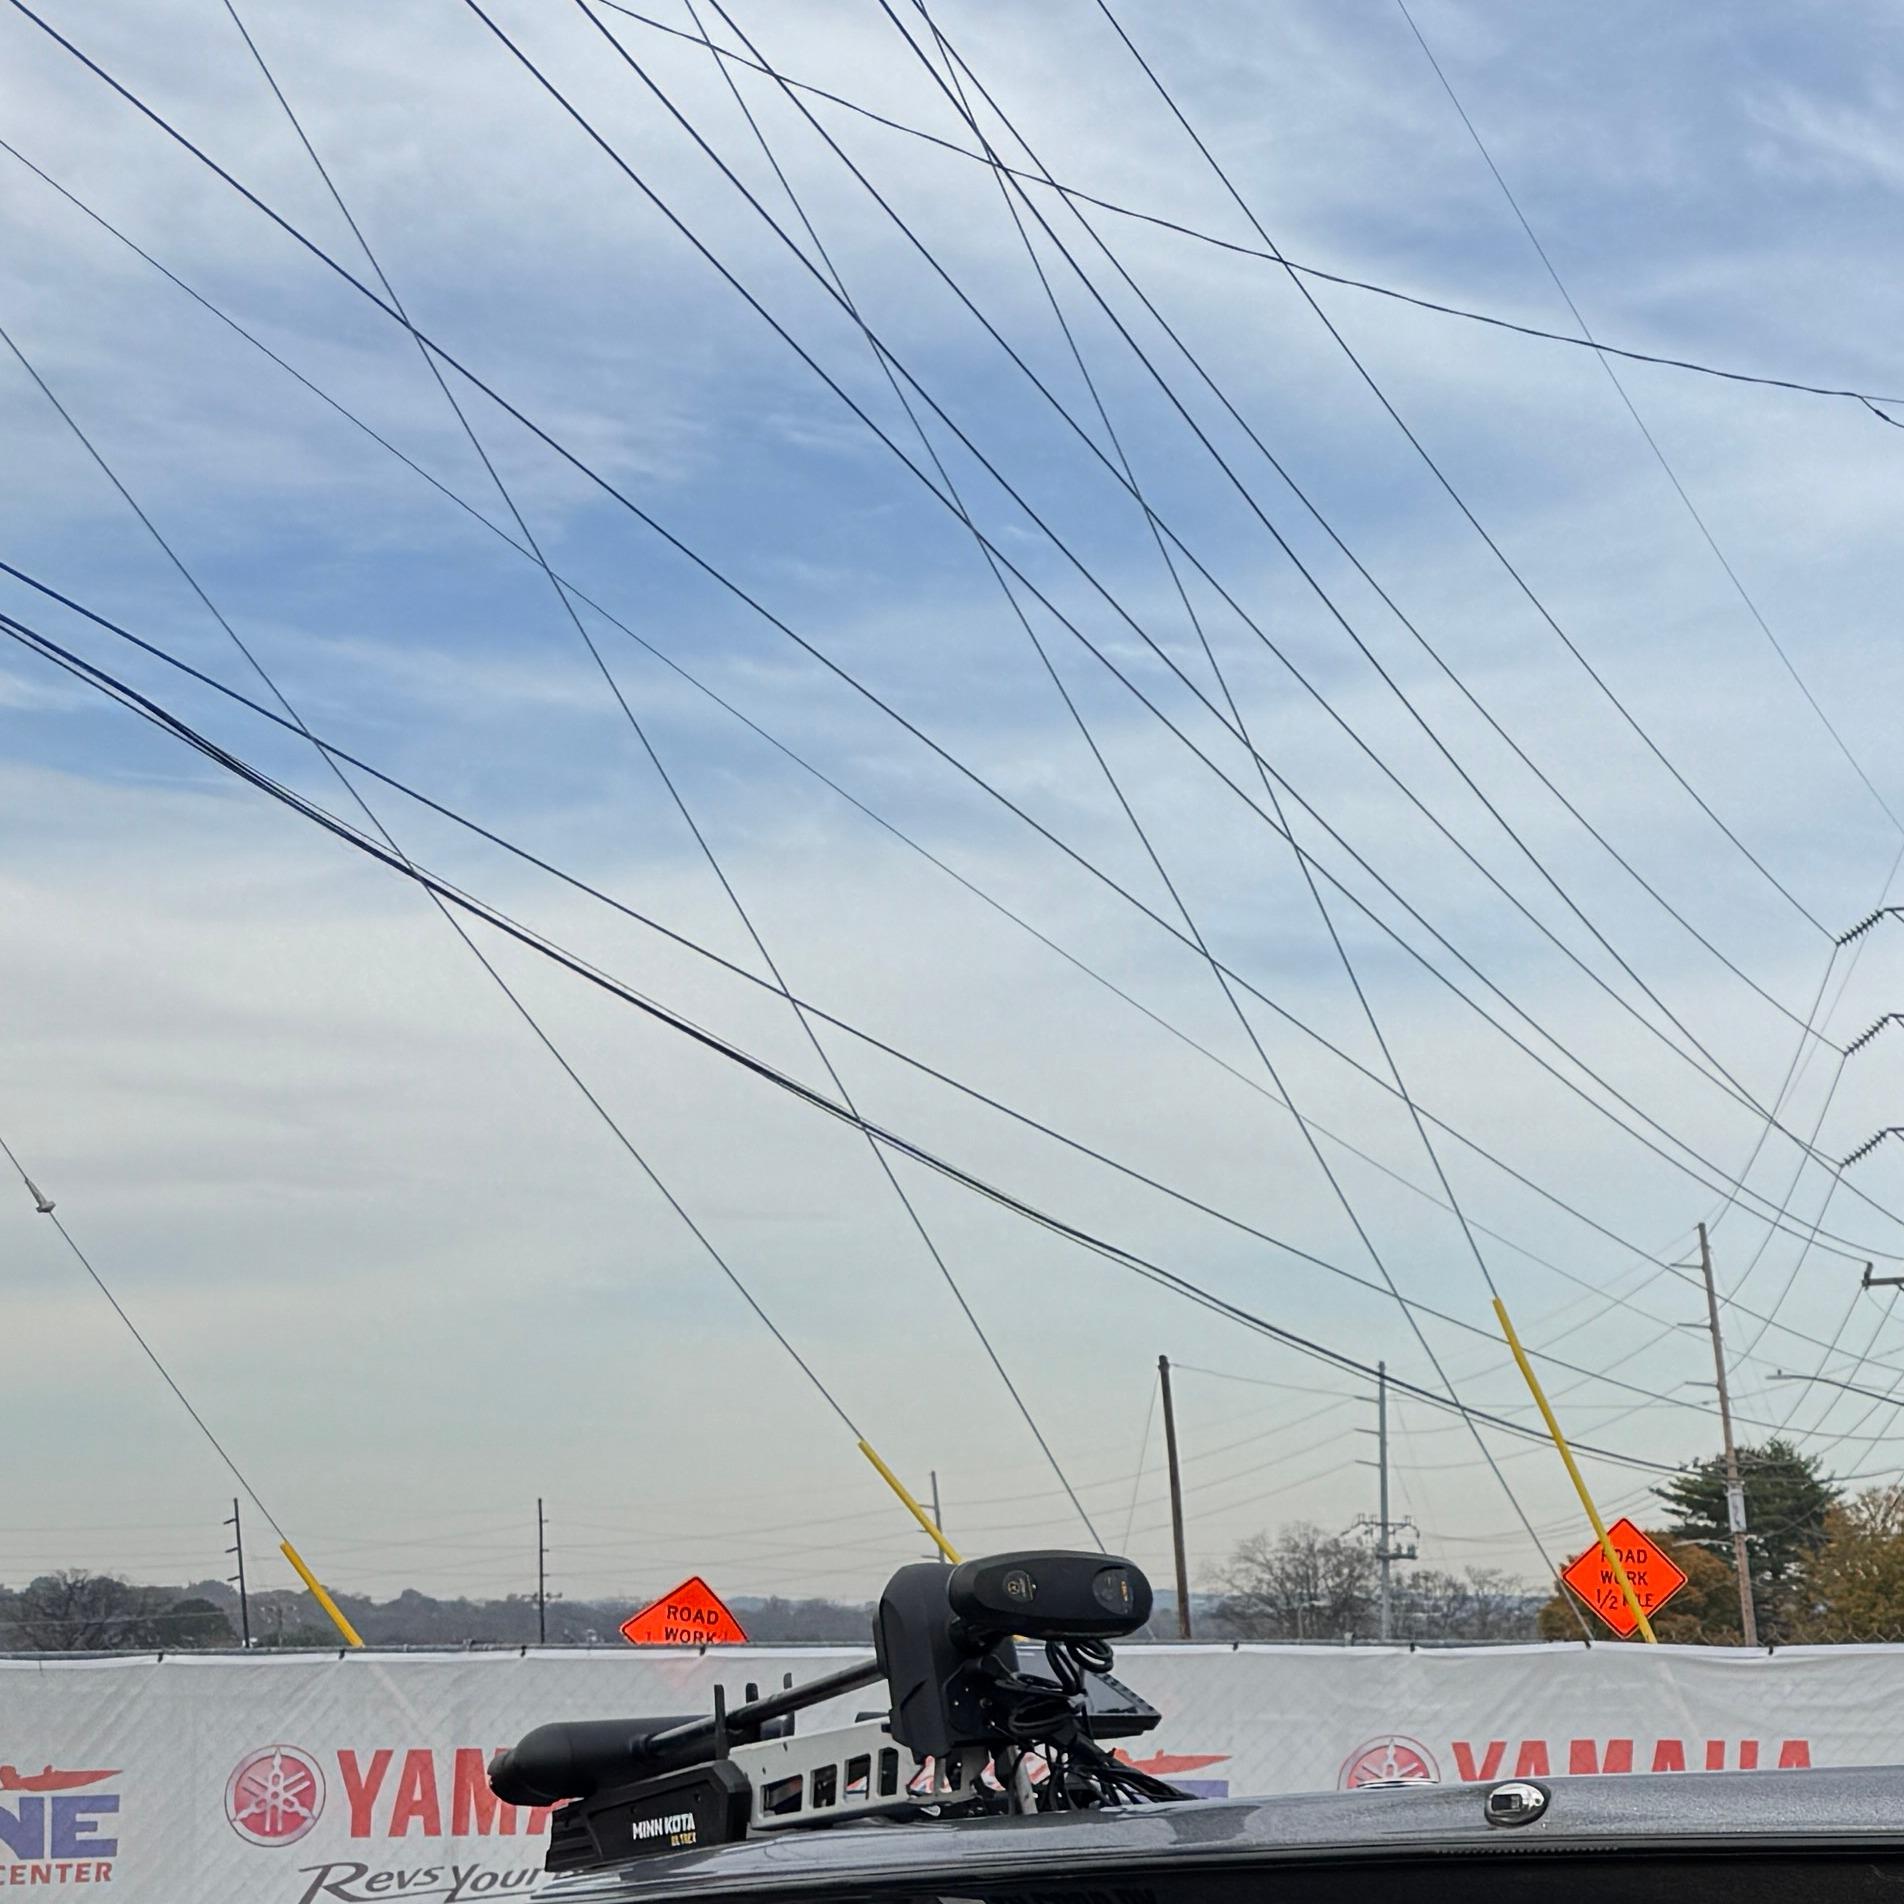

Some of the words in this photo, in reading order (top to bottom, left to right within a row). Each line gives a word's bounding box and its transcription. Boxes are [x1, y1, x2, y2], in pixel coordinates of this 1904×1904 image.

[1596, 1588, 1618, 1610] 1/2
[666, 1605, 719, 1625] ROAD
[664, 1626, 717, 1645] WORK
[632, 1818, 663, 1840] MINN
[663, 1812, 695, 1835] KOTA
[0, 1861, 113, 1886] ENTER
